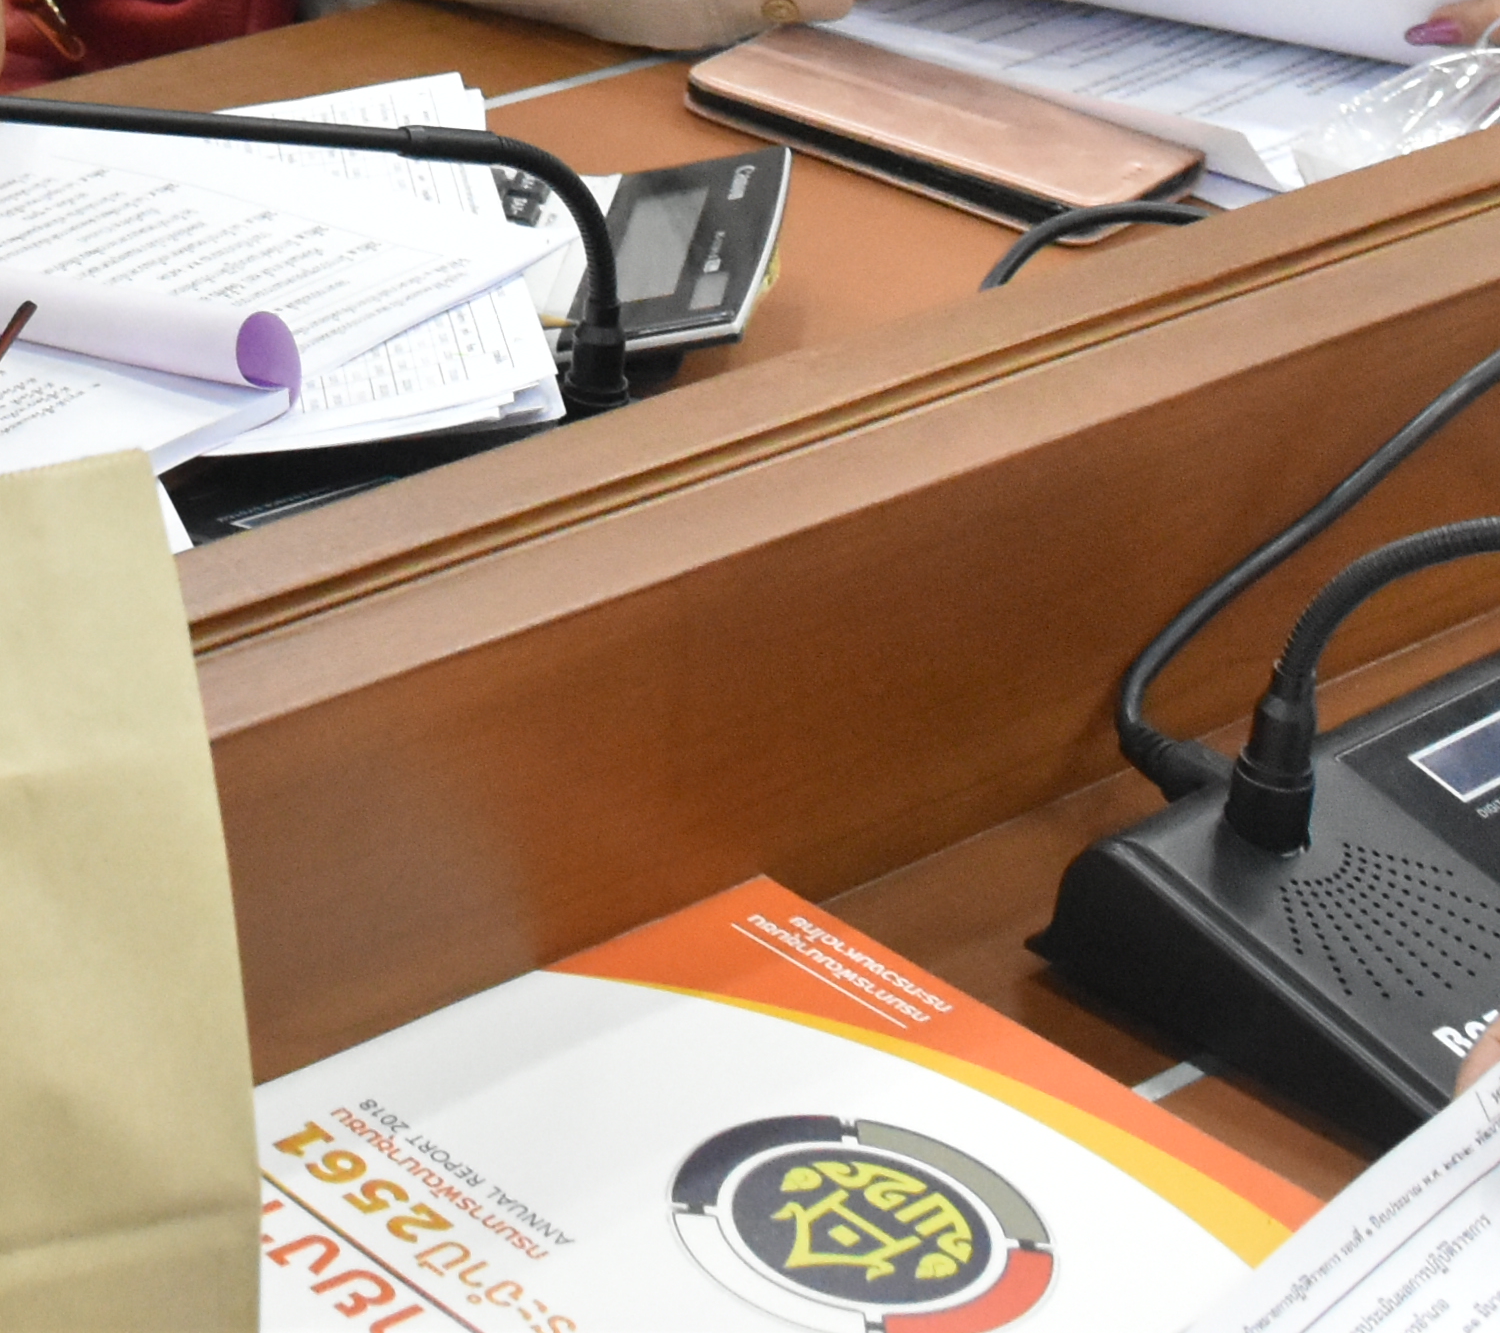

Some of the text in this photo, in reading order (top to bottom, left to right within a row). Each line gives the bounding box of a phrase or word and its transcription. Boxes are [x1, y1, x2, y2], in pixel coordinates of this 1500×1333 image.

[747, 914, 931, 1023] กรมการพัฒนาชุมชน
[788, 916, 954, 1013] กระทรวงมหาดไทย
[272, 1120, 455, 1245] 2561
[330, 1107, 549, 1260] กรมการพัฒนาชุมชน
[358, 1098, 576, 1245] ANNUAL REPORT 2018
